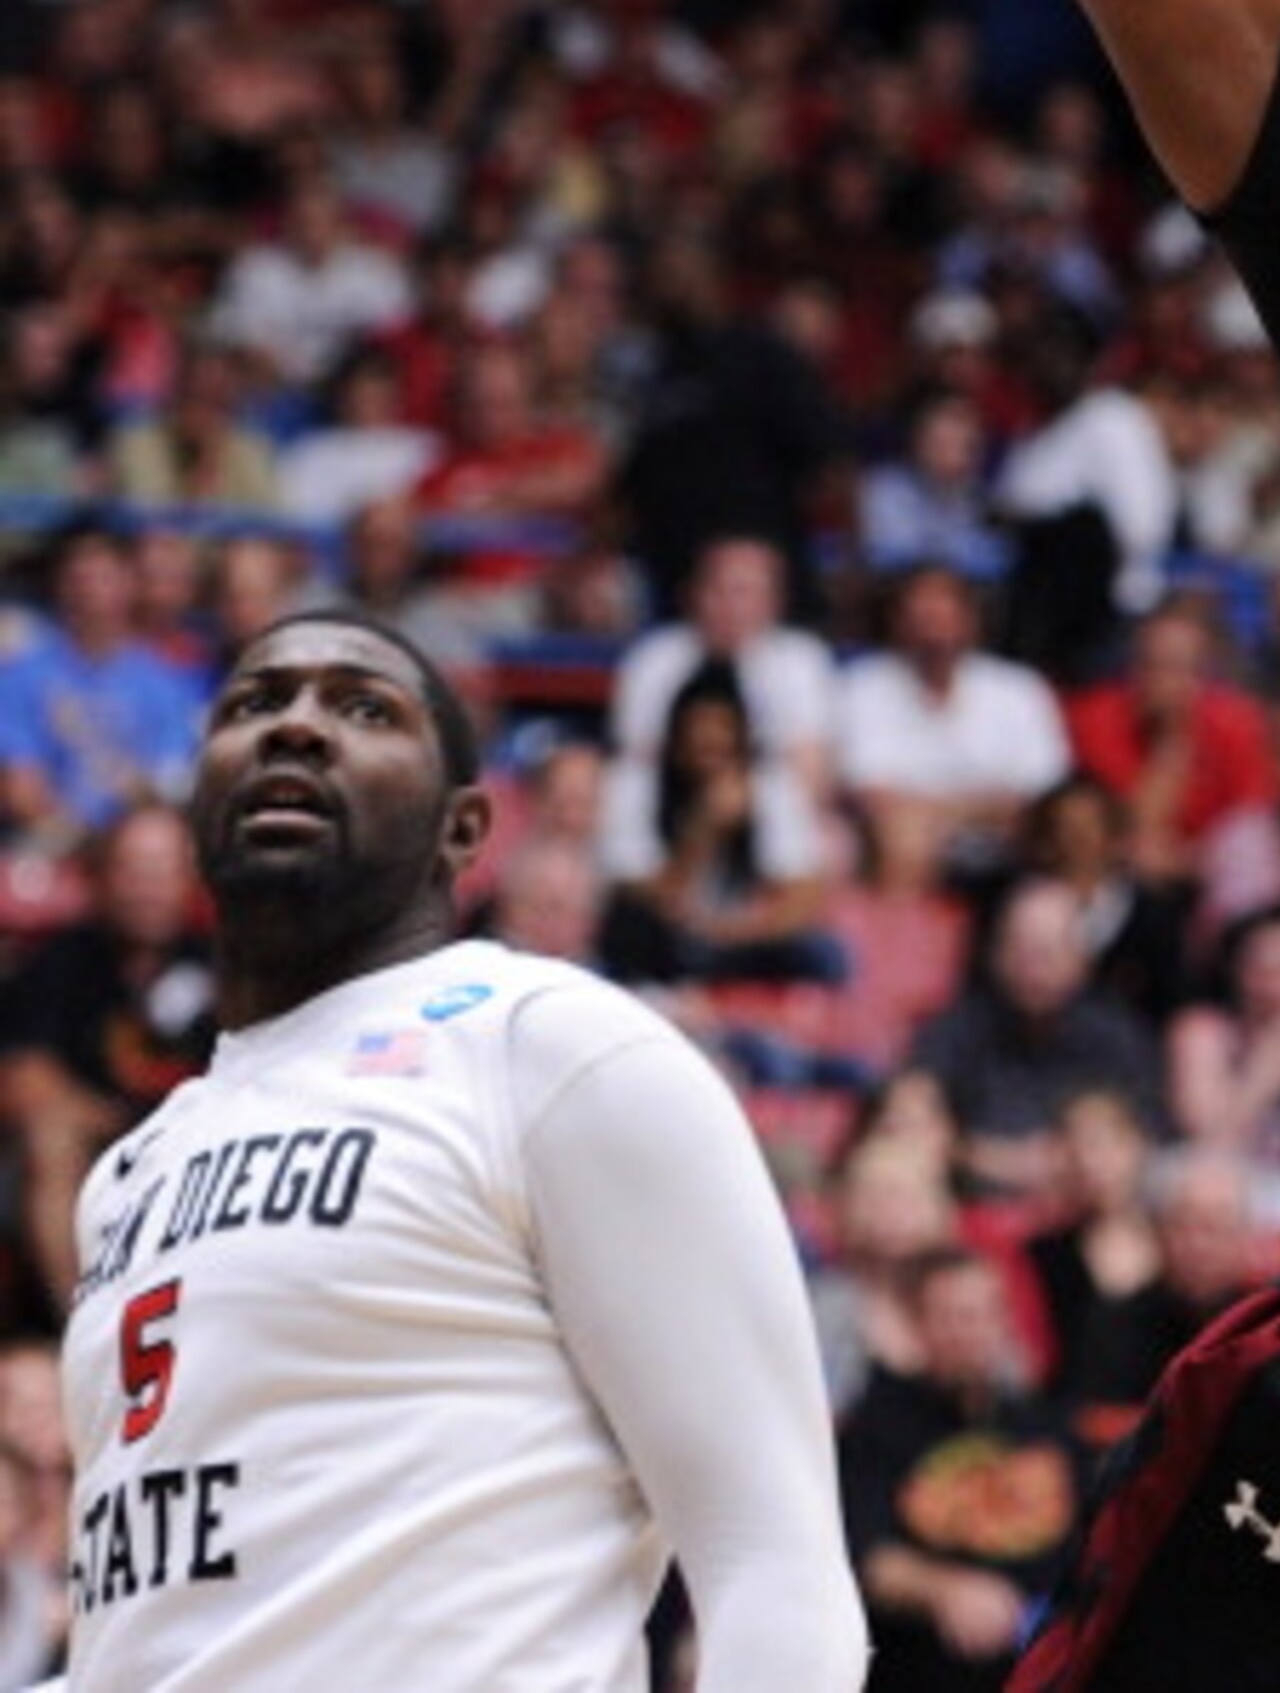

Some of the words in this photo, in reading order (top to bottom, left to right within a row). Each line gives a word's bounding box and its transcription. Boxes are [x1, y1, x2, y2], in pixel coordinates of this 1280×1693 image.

[158, 1127, 377, 1253] DIEGO
[119, 1275, 182, 1447] 5
[72, 1462, 239, 1615] TATE
